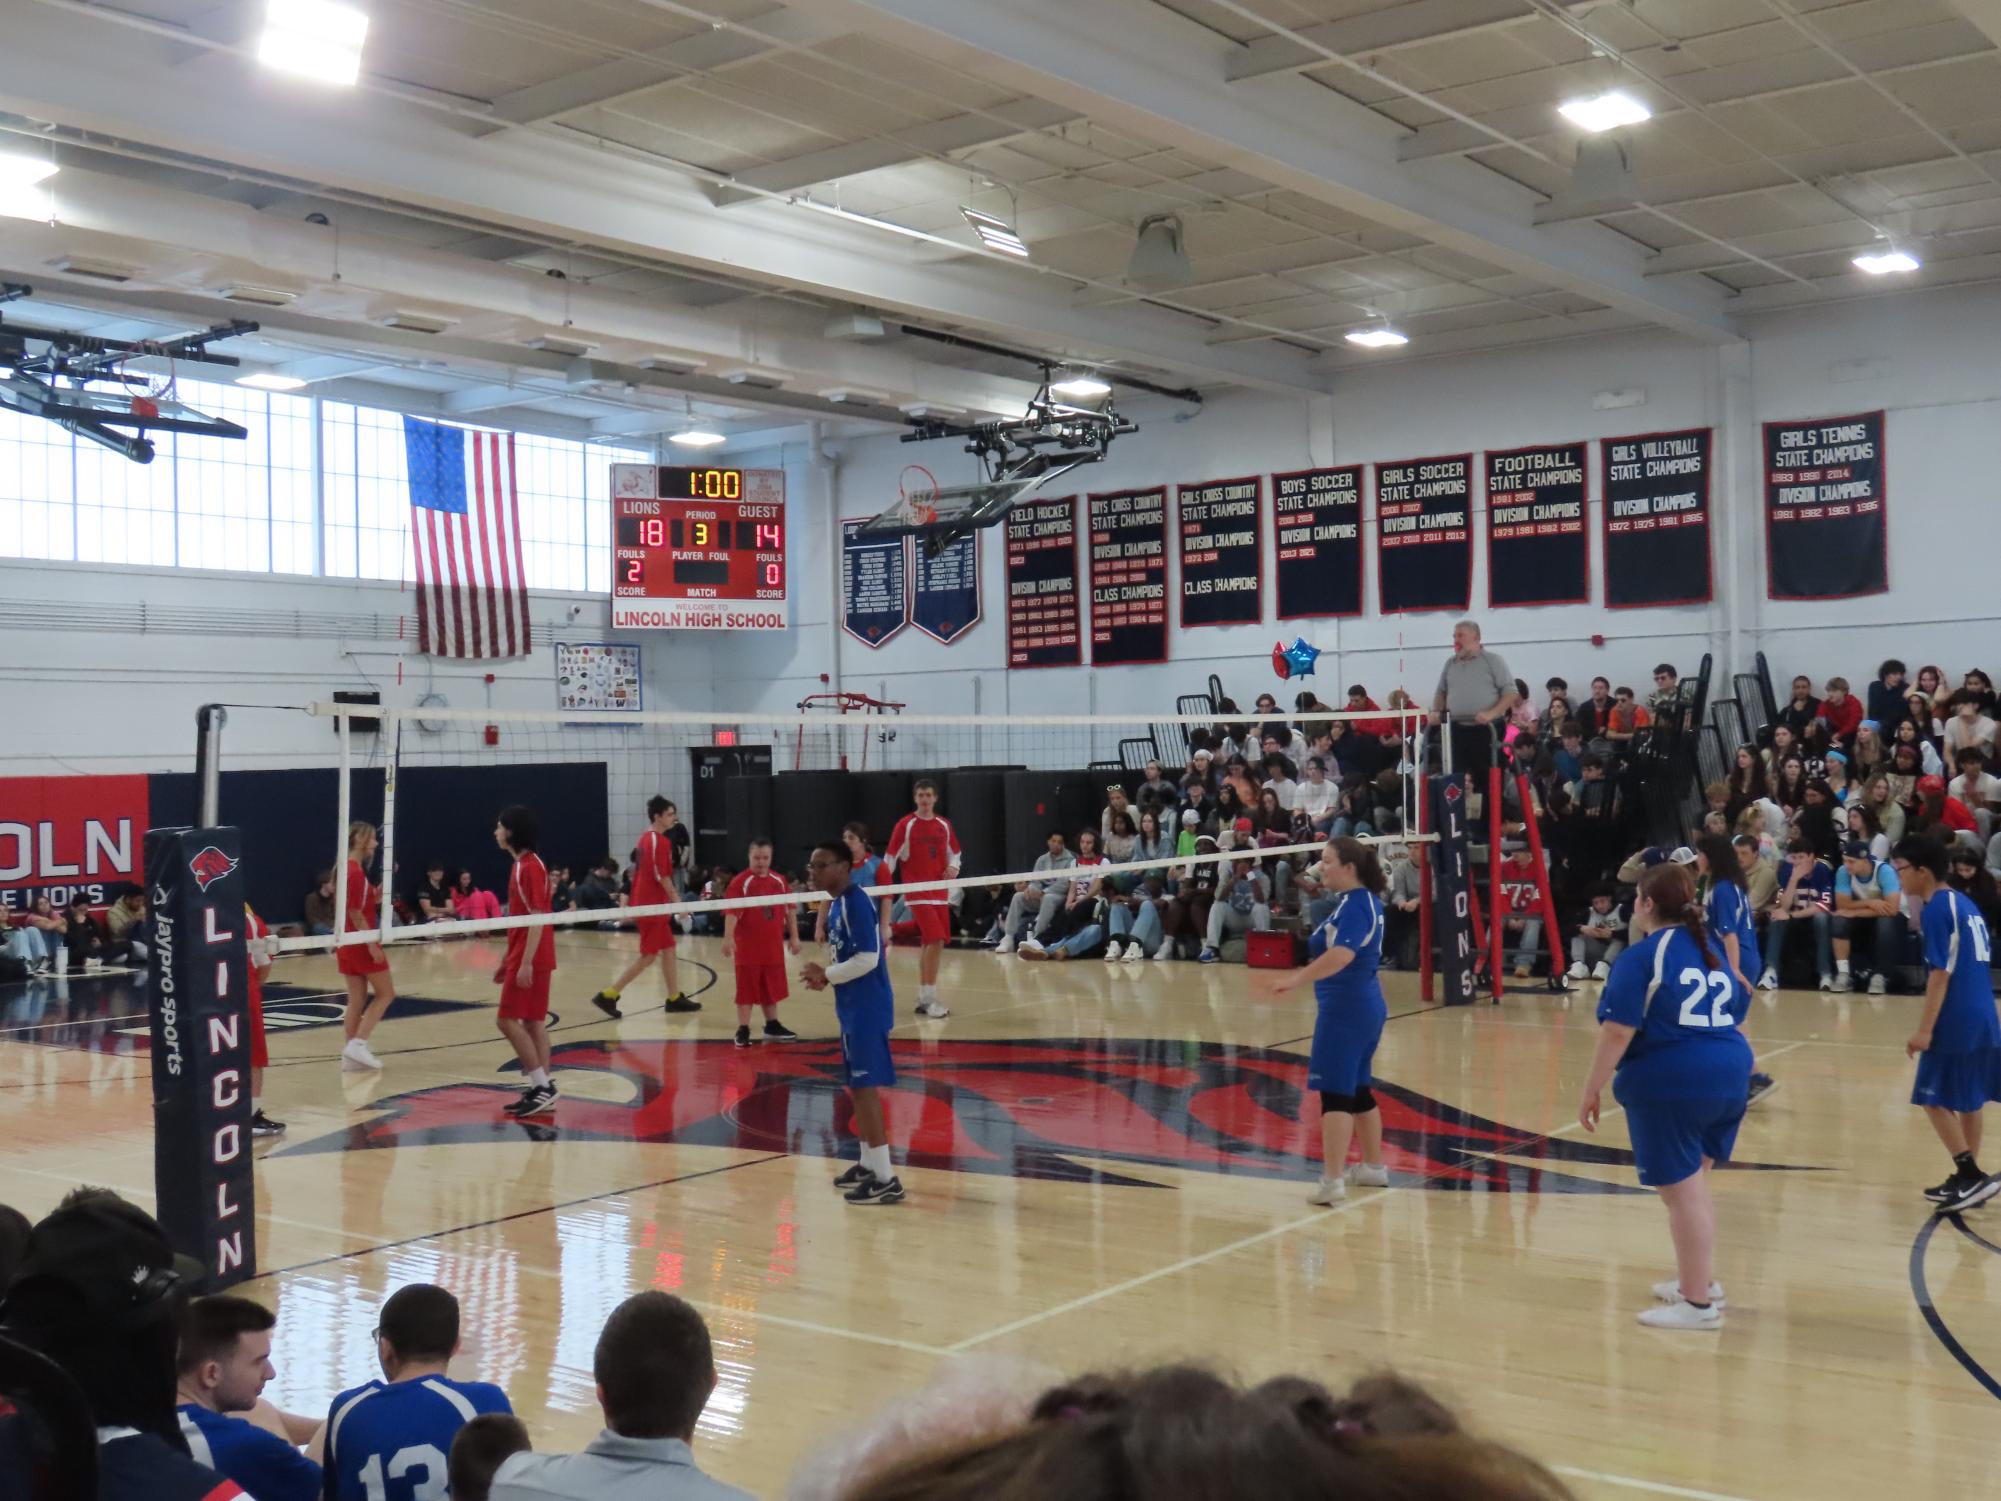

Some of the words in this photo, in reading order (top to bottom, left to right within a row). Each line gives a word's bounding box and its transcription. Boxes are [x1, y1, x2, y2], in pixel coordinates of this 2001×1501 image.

[1780, 430, 1817, 448] GIRLS
[1820, 424, 1866, 444] TENNIS
[1612, 445, 1636, 462] GIRLS
[1642, 439, 1698, 457] VOLLEYBALL
[1776, 451, 1809, 467] STATE
[1813, 443, 1873, 464] CHAMPIONS
[1495, 452, 1575, 473] FOOTBALL
[1611, 464, 1642, 481] STATE
[1647, 457, 1700, 477] CHAMPIONS
[1281, 479, 1306, 494] BOYS
[1311, 473, 1352, 490] SOCCER
[1383, 468, 1414, 484] GIRLS
[1420, 463, 1464, 479] SOCCER
[1490, 473, 1522, 490] STATE
[1527, 469, 1582, 487] CHAMPIONS
[1827, 468, 1849, 479] 2014
[690, 471, 739, 498] 1:00
[1181, 491, 1200, 504] GIRLS
[1203, 487, 1222, 502] CROSS
[1225, 484, 1255, 500] COUNTRY
[1381, 485, 1410, 502] STATE
[1414, 480, 1466, 497] CHAMPIONS
[1779, 487, 1815, 503] DIVISION
[1820, 481, 1871, 501] CHAMPIONS
[624, 502, 660, 515] LIONS
[1112, 498, 1131, 512] CROSS
[1134, 495, 1161, 510] COUNTRY
[1278, 496, 1303, 511] STATE
[1307, 490, 1357, 507] CHAMPIONS
[1491, 495, 1511, 504] 1981
[1614, 499, 1649, 517] DIVISION
[1653, 492, 1696, 512] CHAMPIONS
[686, 511, 716, 520] PERIOD
[738, 505, 778, 518] GUEST
[1010, 508, 1033, 522] FIELD
[1037, 504, 1070, 519] HOCKEY
[1093, 516, 1117, 530] STATE
[1121, 511, 1163, 527] CHAMPIONS
[1183, 507, 1208, 521] STATE
[1211, 501, 1254, 518] CHAMPIONS
[1494, 507, 1529, 524] DIVISION
[1534, 502, 1580, 520] CHAMPIONS
[1773, 509, 1794, 519] 1981
[1800, 507, 1822, 518] 1982
[640, 520, 663, 545] 18
[1009, 525, 1031, 539] STATE
[1034, 520, 1071, 536] CHAMPIONS
[1384, 515, 1416, 533] DIVISION
[1420, 512, 1463, 528] CHAMPIONS
[1494, 528, 1513, 537] 1979
[1516, 526, 1534, 535] 1981
[1609, 522, 1629, 531] 1972
[696, 523, 707, 545] 3
[756, 525, 779, 548] 14
[1185, 536, 1213, 550] DIVISION
[1215, 532, 1254, 547] CHAMPIONS
[1281, 528, 1311, 544] DIVISION
[1314, 524, 1356, 540] CHAMPIONS
[1423, 533, 1442, 542] 2011
[1445, 532, 1465, 540] 2013
[672, 552, 703, 560] PLAYER
[709, 552, 730, 561] FOUL
[756, 554, 782, 562] FOULS
[1094, 545, 1121, 560] DIVISION
[1125, 541, 1161, 555] CHAMPIONS
[628, 561, 641, 582] 2
[766, 564, 779, 585] 0
[618, 587, 645, 596] SCORE
[687, 589, 716, 597] MATCH
[757, 590, 783, 598] SCORE
[1012, 581, 1036, 596] DIVISION
[1039, 577, 1072, 593] CHAMPIONS
[1094, 588, 1118, 602] CLASS
[1121, 584, 1163, 600] CHAMPIONS
[1185, 580, 1212, 595] CLASS
[1215, 577, 1257, 592] CHAMPIONS
[616, 612, 680, 627] LINCOLN
[686, 613, 721, 627] HIGH
[727, 614, 785, 628] SCHOOL
[700, 765, 715, 778] D1
[0, 818, 132, 881] OLN
[1450, 812, 1473, 996] LIONS
[155, 912, 176, 994] jaypro
[1678, 967, 1735, 1028] 22
[159, 997, 184, 1077] sports
[203, 906, 243, 1276] LINCOLN
